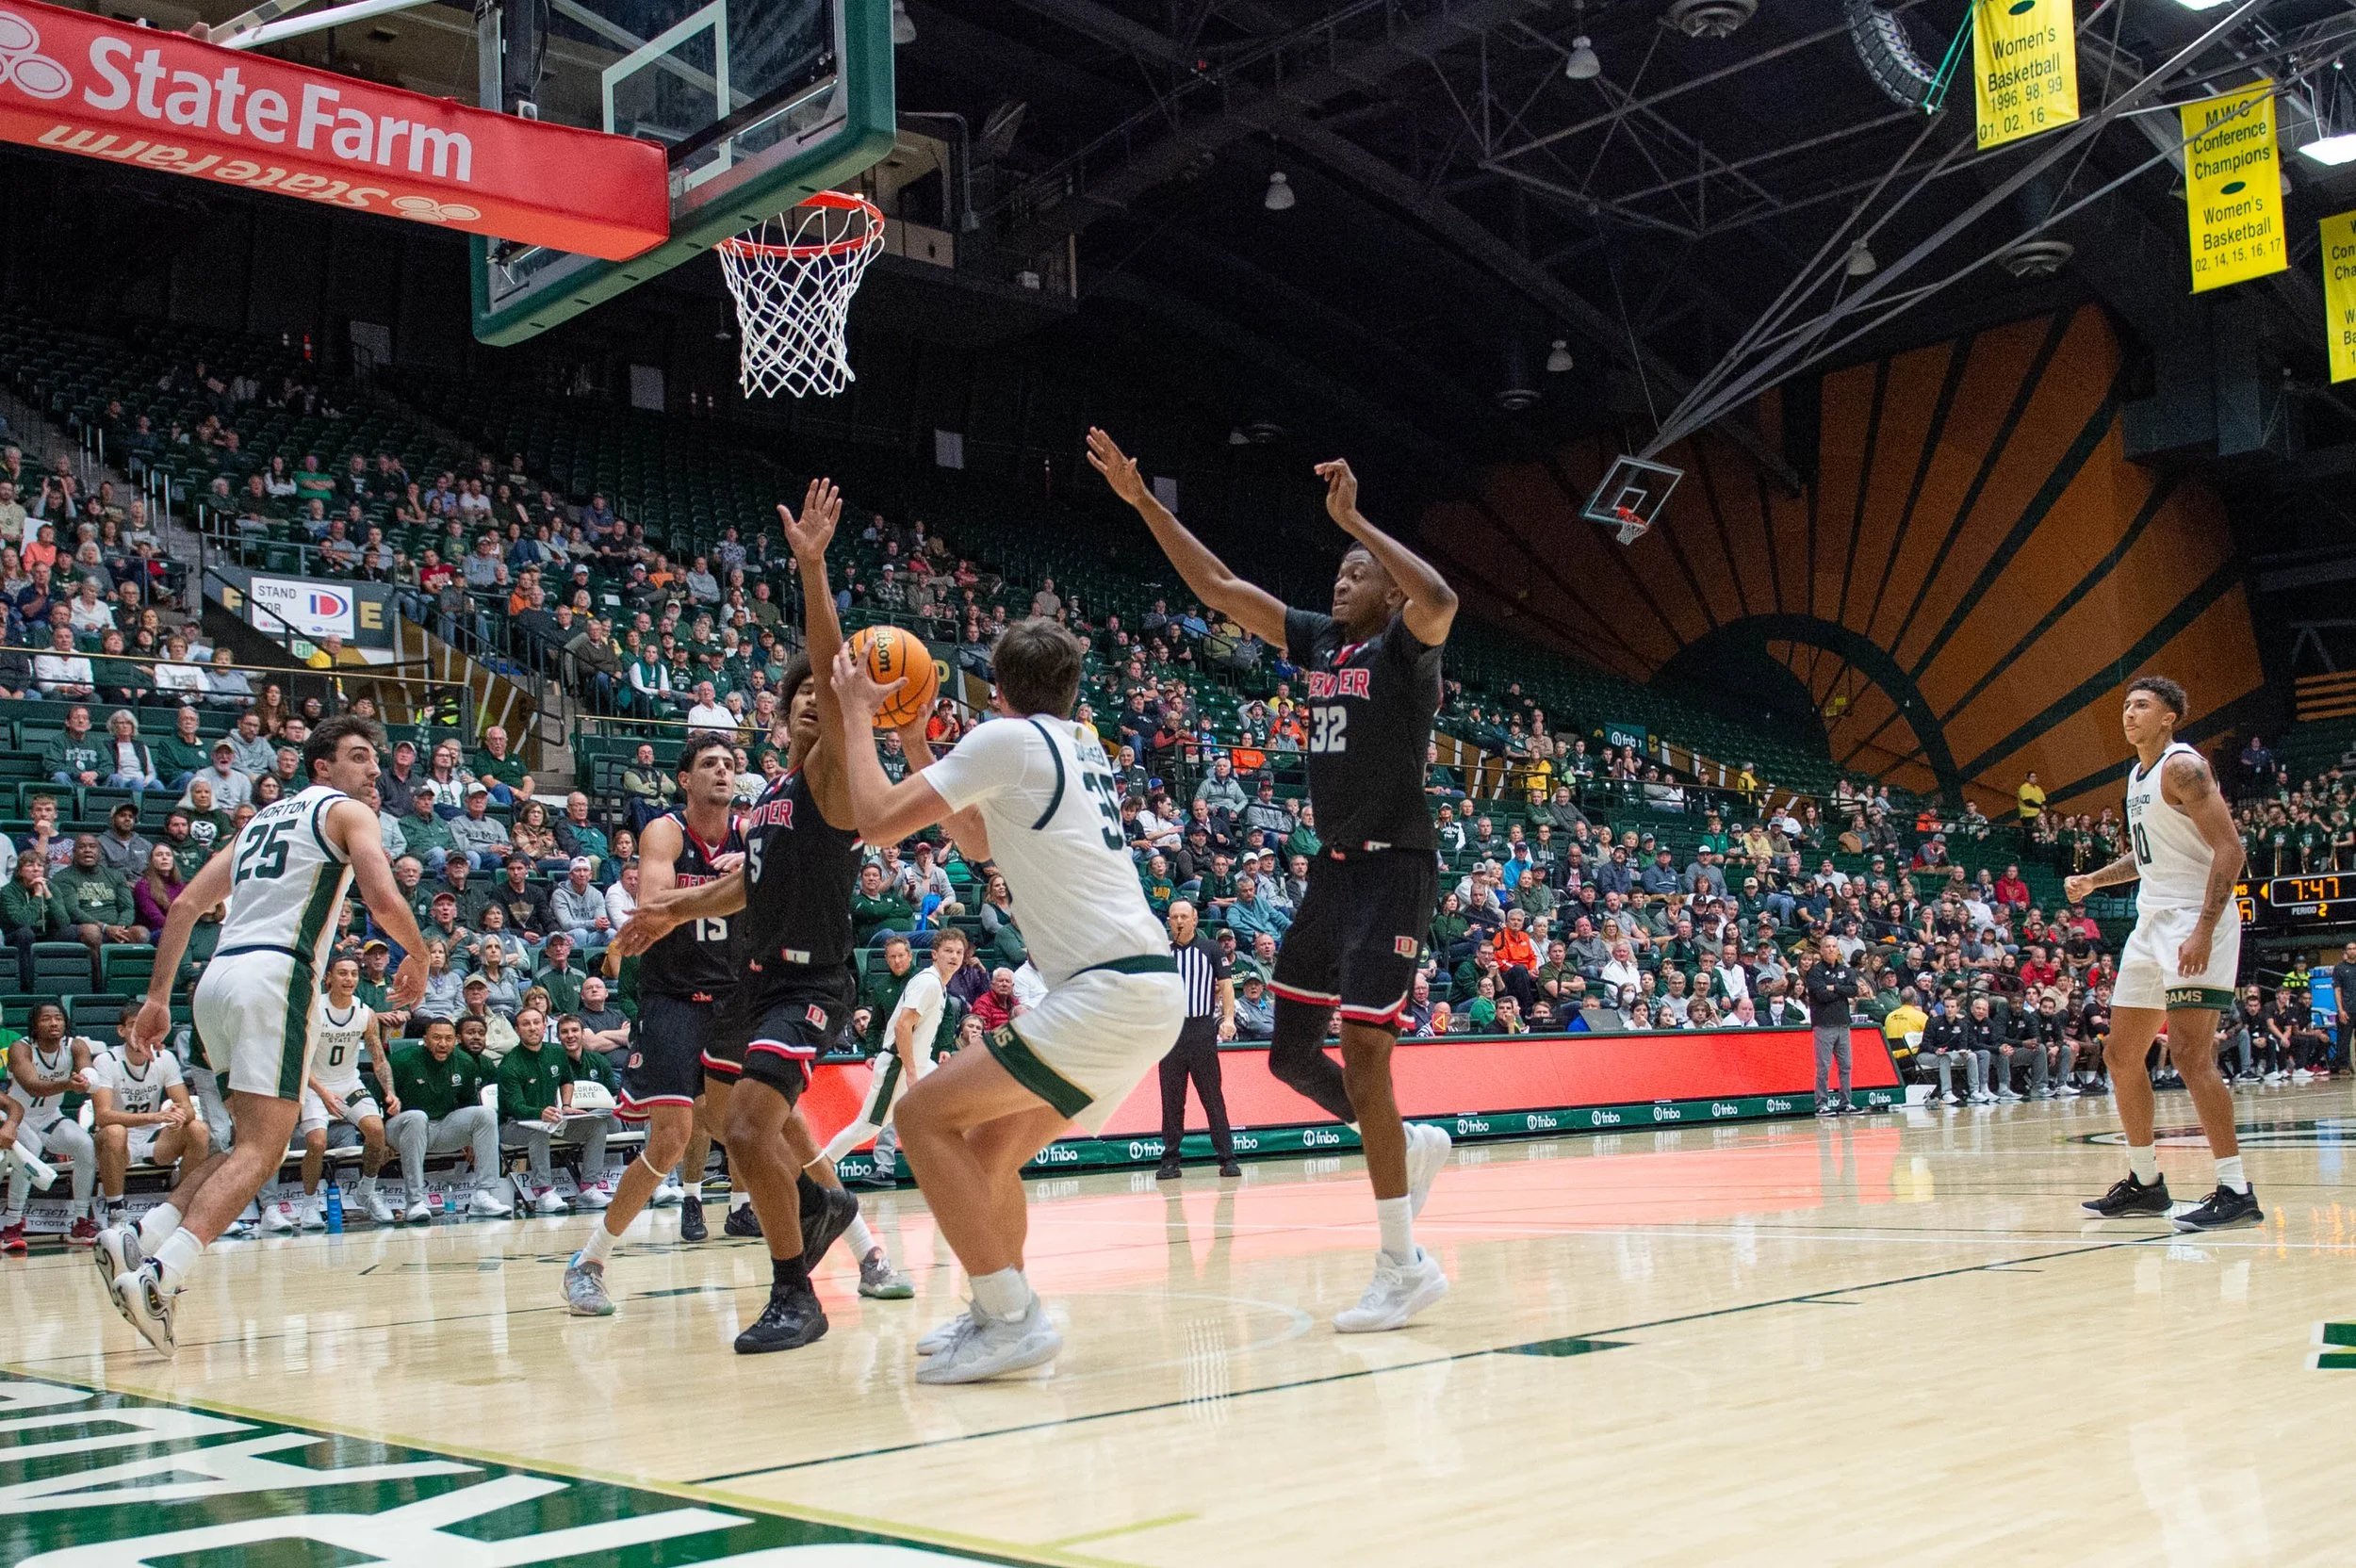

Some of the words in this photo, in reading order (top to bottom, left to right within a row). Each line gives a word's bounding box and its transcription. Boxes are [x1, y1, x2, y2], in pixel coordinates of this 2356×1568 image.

[1992, 25, 2056, 60] Women's
[1988, 53, 2061, 92] Basketball
[1990, 90, 2022, 113] 1996,
[2048, 75, 2063, 95] 99
[2030, 106, 2045, 125] 16
[2193, 122, 2266, 155] Conference
[2195, 146, 2270, 180] Champions
[2203, 195, 2263, 225] Women's
[2203, 217, 2271, 251] Basketball
[2270, 237, 2282, 253] 17
[258, 585, 297, 599] STAND
[360, 601, 383, 629] E
[1310, 705, 1348, 753] 32
[255, 800, 311, 820] MORTON
[235, 818, 299, 886] 25
[2132, 822, 2152, 866] 10
[2290, 876, 2339, 901] 7:47
[2292, 906, 2317, 916] PERIOD
[2318, 903, 2328, 918] 2
[696, 918, 728, 941] 15
[329, 1045, 345, 1066] 0
[1775, 1100, 1791, 1111] fnbo
[1876, 1093, 1891, 1103] fnbo
[1602, 1111, 1620, 1124] fnbo
[1662, 1107, 1681, 1119] fnbo
[1721, 1103, 1738, 1116] fnbo
[1468, 1119, 1489, 1133] fnbo
[1538, 1115, 1557, 1128] fnbo
[1233, 1135, 1258, 1151] fnbo
[1316, 1131, 1339, 1145] fnbo
[1050, 1146, 1078, 1162] fnbo
[840, 1161, 872, 1178] fnbo
